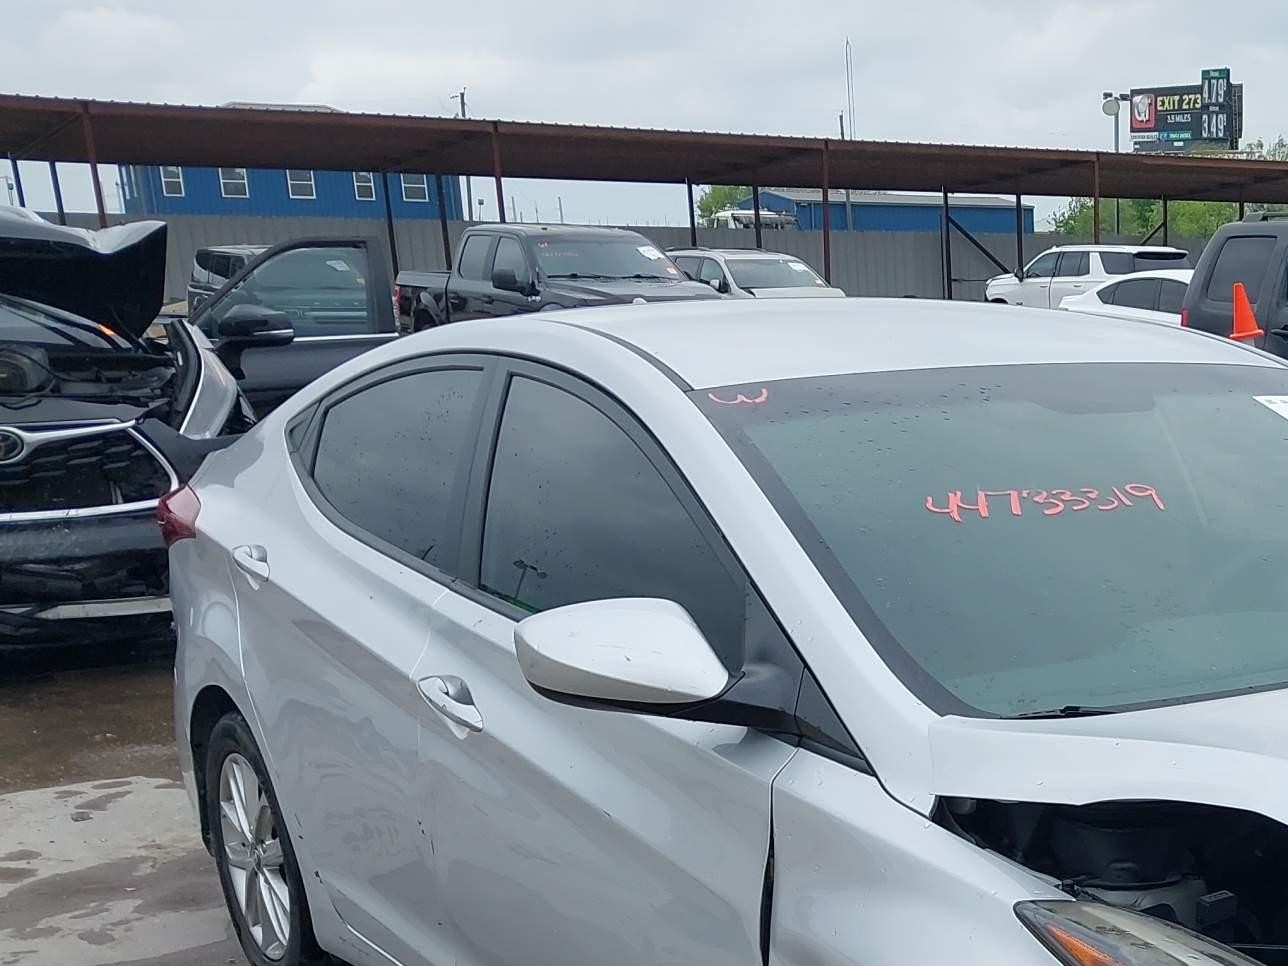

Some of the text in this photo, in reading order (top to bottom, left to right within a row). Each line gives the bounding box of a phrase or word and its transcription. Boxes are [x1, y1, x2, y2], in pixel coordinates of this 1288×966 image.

[1157, 94, 1202, 110] EXIT 273
[925, 483, 1165, 522] 44733319
